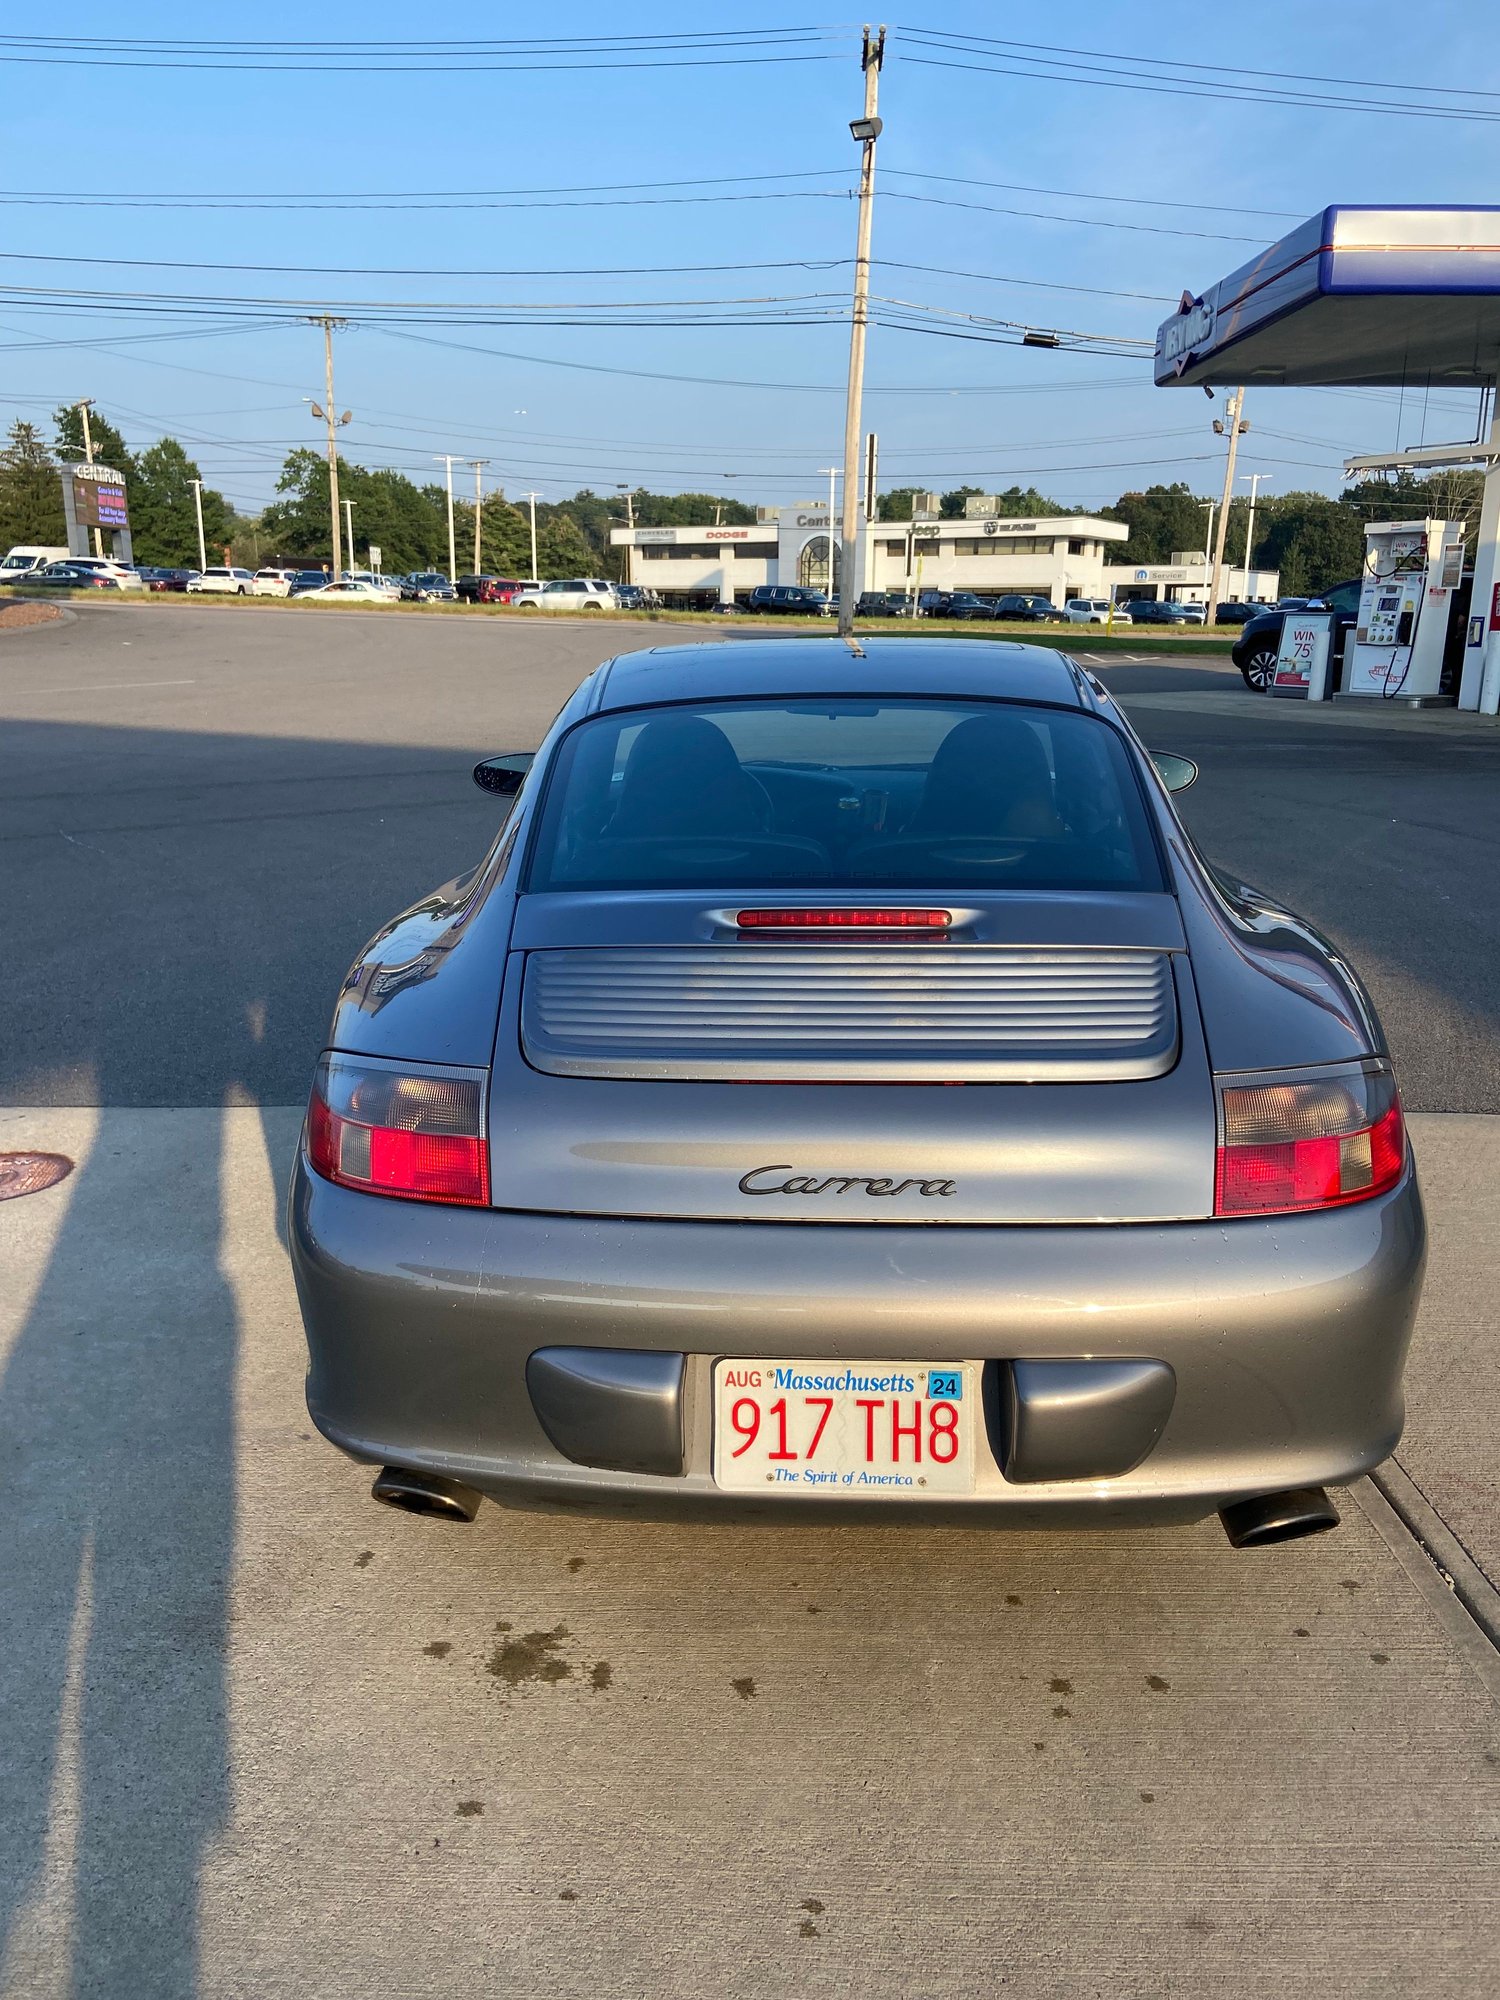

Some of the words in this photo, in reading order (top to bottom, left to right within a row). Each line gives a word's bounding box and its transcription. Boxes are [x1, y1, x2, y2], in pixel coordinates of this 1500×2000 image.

[1165, 304, 1213, 361] IRVING
[76, 465, 126, 486] CENTRAL
[797, 515, 843, 527] Centa
[706, 531, 748, 539] DODGE
[906, 523, 940, 539] Jeep
[1294, 631, 1315, 641] WIN
[738, 1164, 957, 1196] Carrera
[725, 1371, 762, 1387] AUG
[773, 1368, 914, 1393] Massachusetts
[933, 1379, 957, 1395] 24
[731, 1397, 834, 1460] 917
[856, 1399, 959, 1464] TH8
[774, 1468, 800, 1482] The
[803, 1469, 838, 1484] Spirit
[842, 1471, 855, 1486] of
[857, 1472, 913, 1486] America
